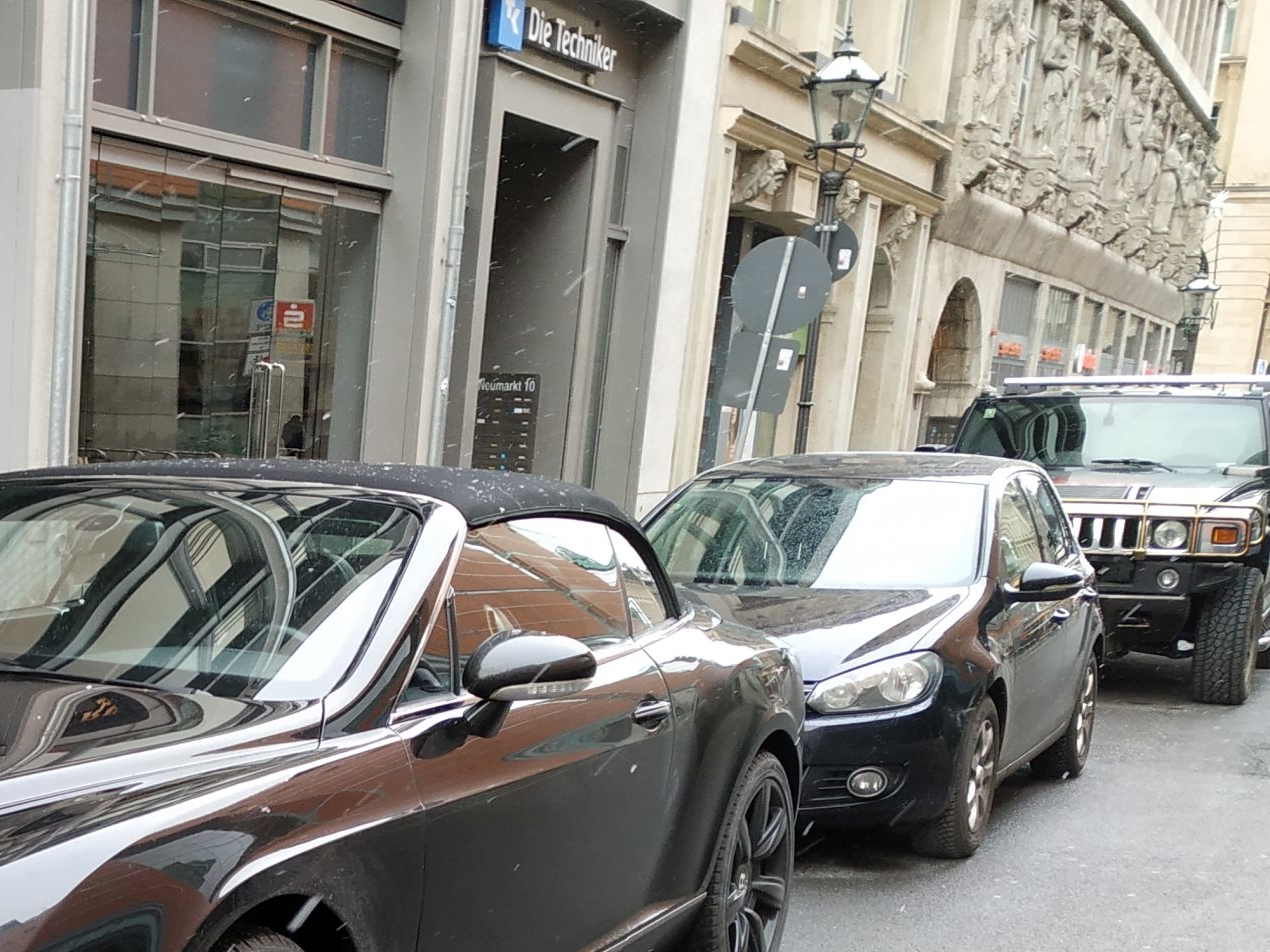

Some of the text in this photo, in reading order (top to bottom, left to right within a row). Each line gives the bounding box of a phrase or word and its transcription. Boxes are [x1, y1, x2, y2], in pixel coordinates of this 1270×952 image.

[528, 7, 618, 72] Die Techniker
[478, 379, 536, 393] Neumarkt 10
